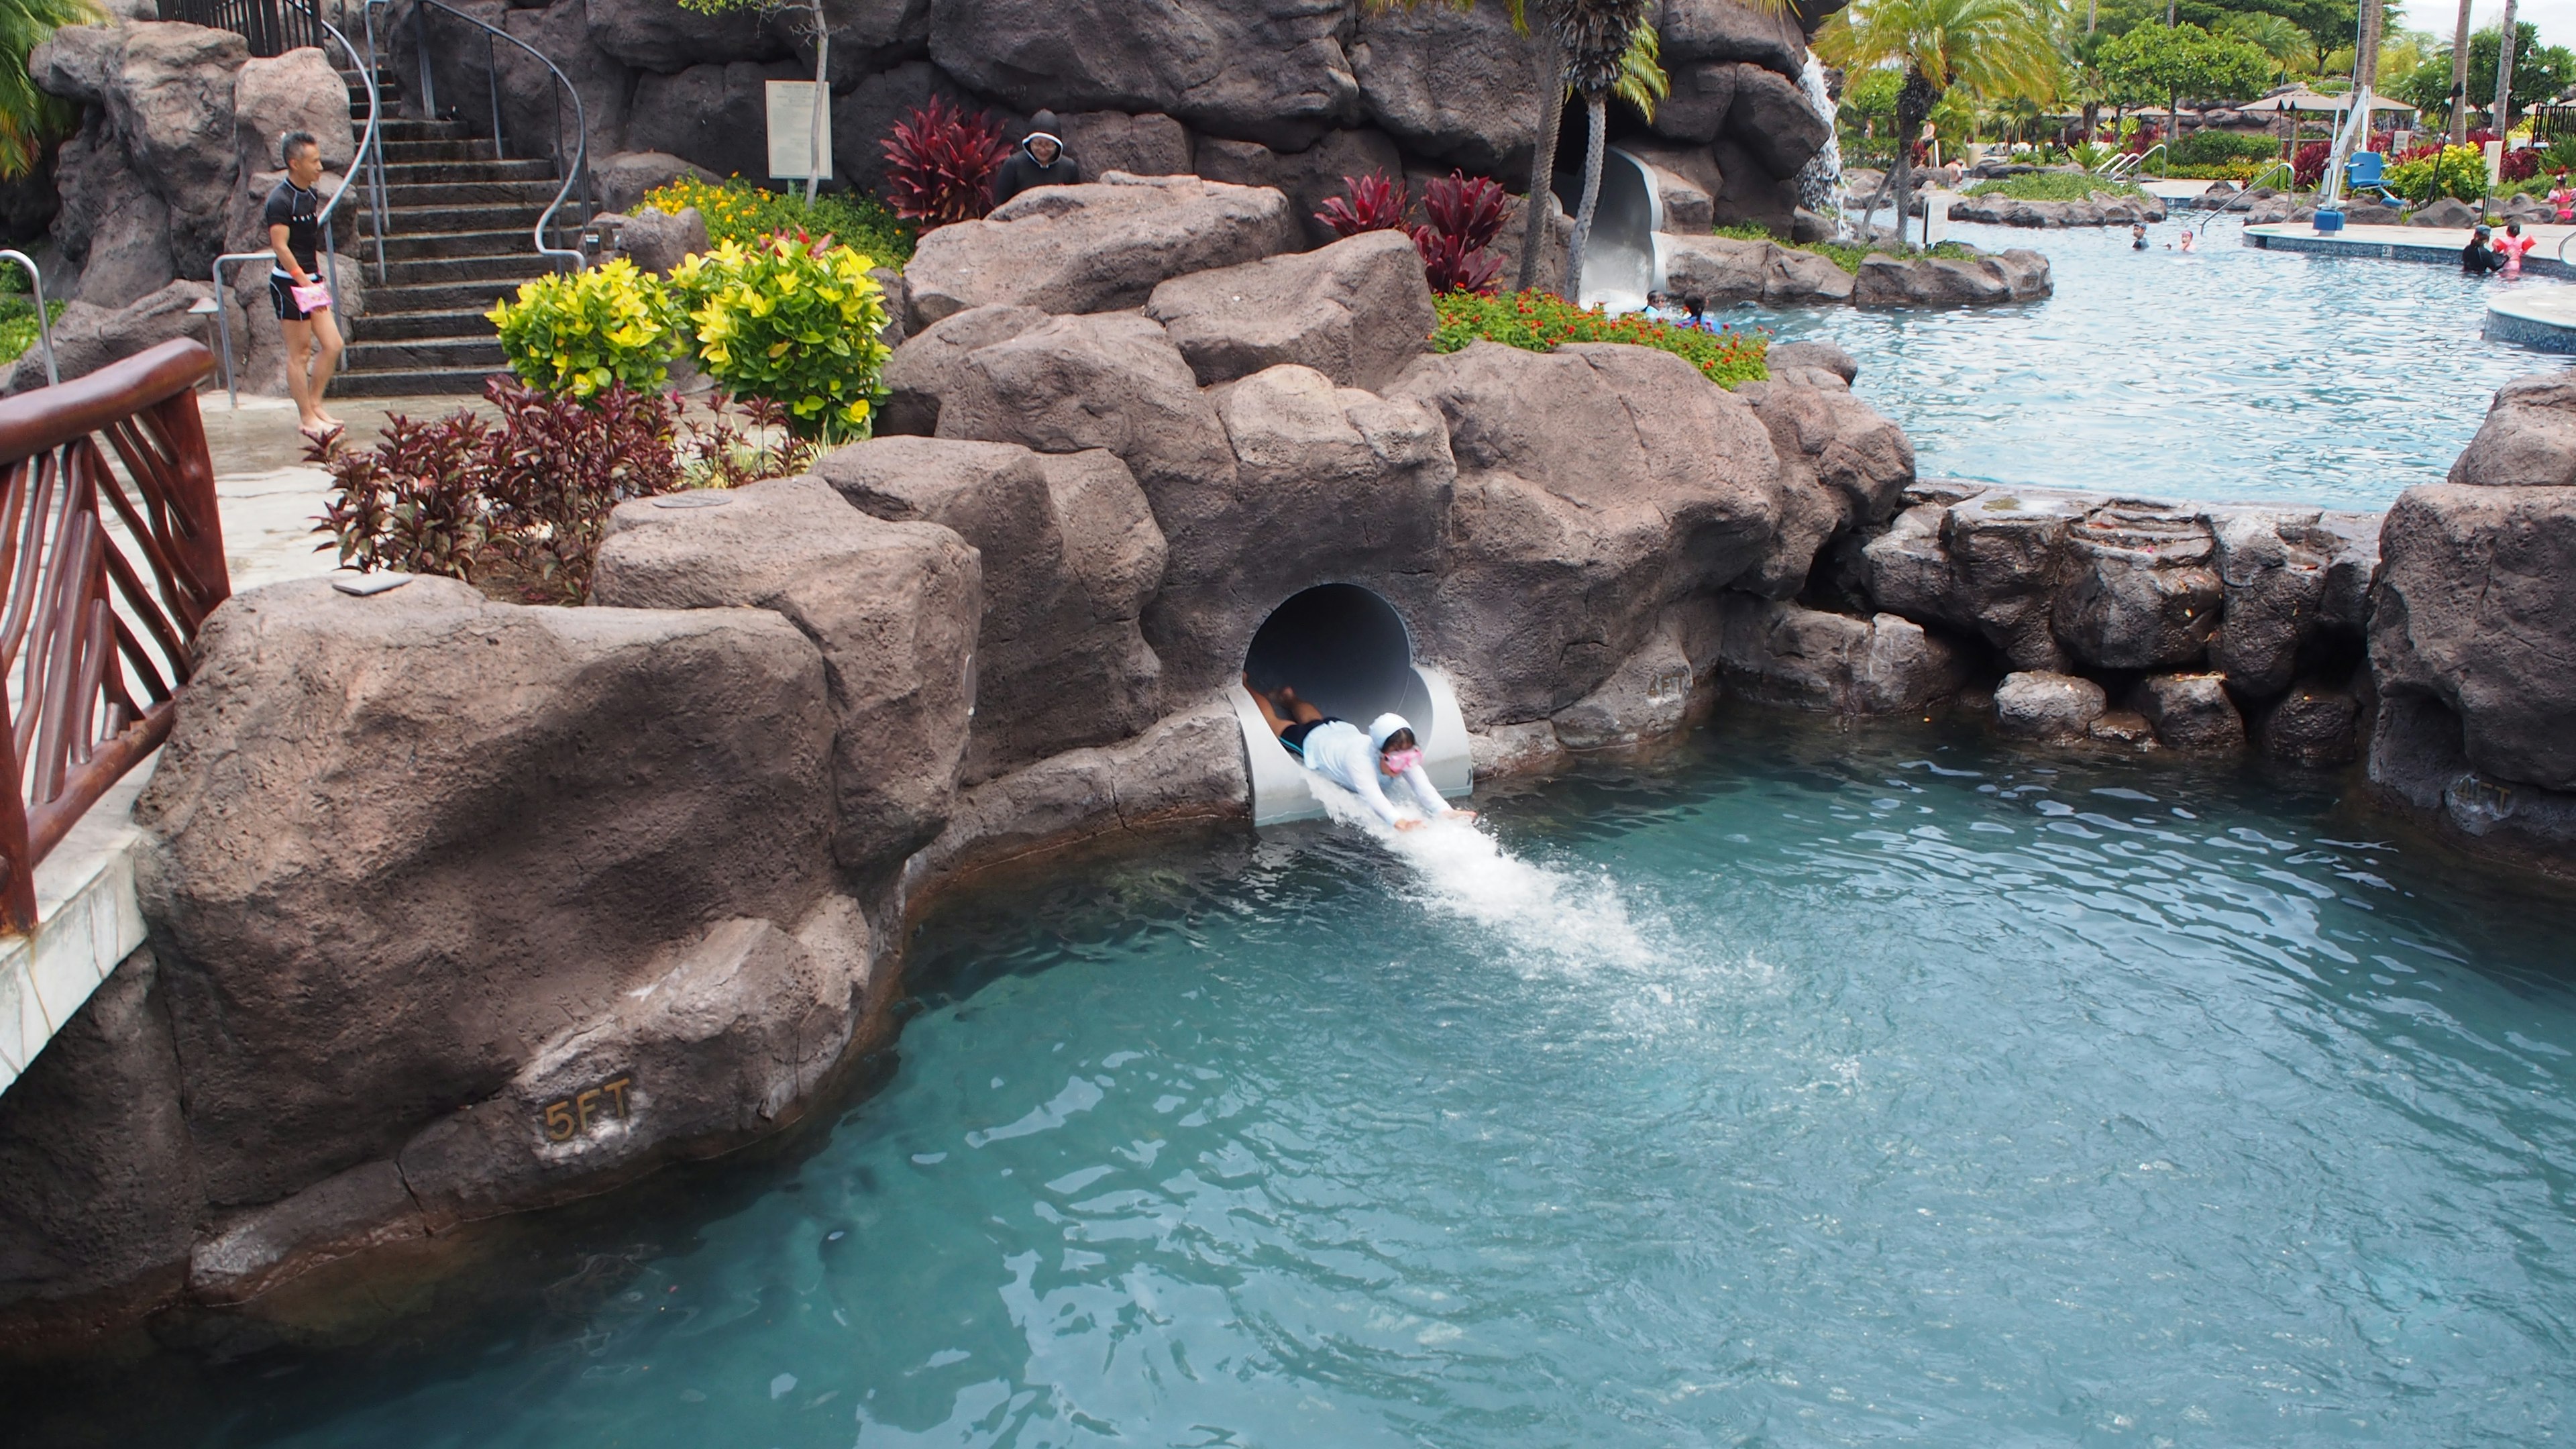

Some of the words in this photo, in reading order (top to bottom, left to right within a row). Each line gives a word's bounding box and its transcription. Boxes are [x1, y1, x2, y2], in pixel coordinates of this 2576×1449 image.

[1647, 672, 1685, 698] 4FT
[2455, 778, 2512, 814] 4FT
[545, 1077, 631, 1141] 5FT
